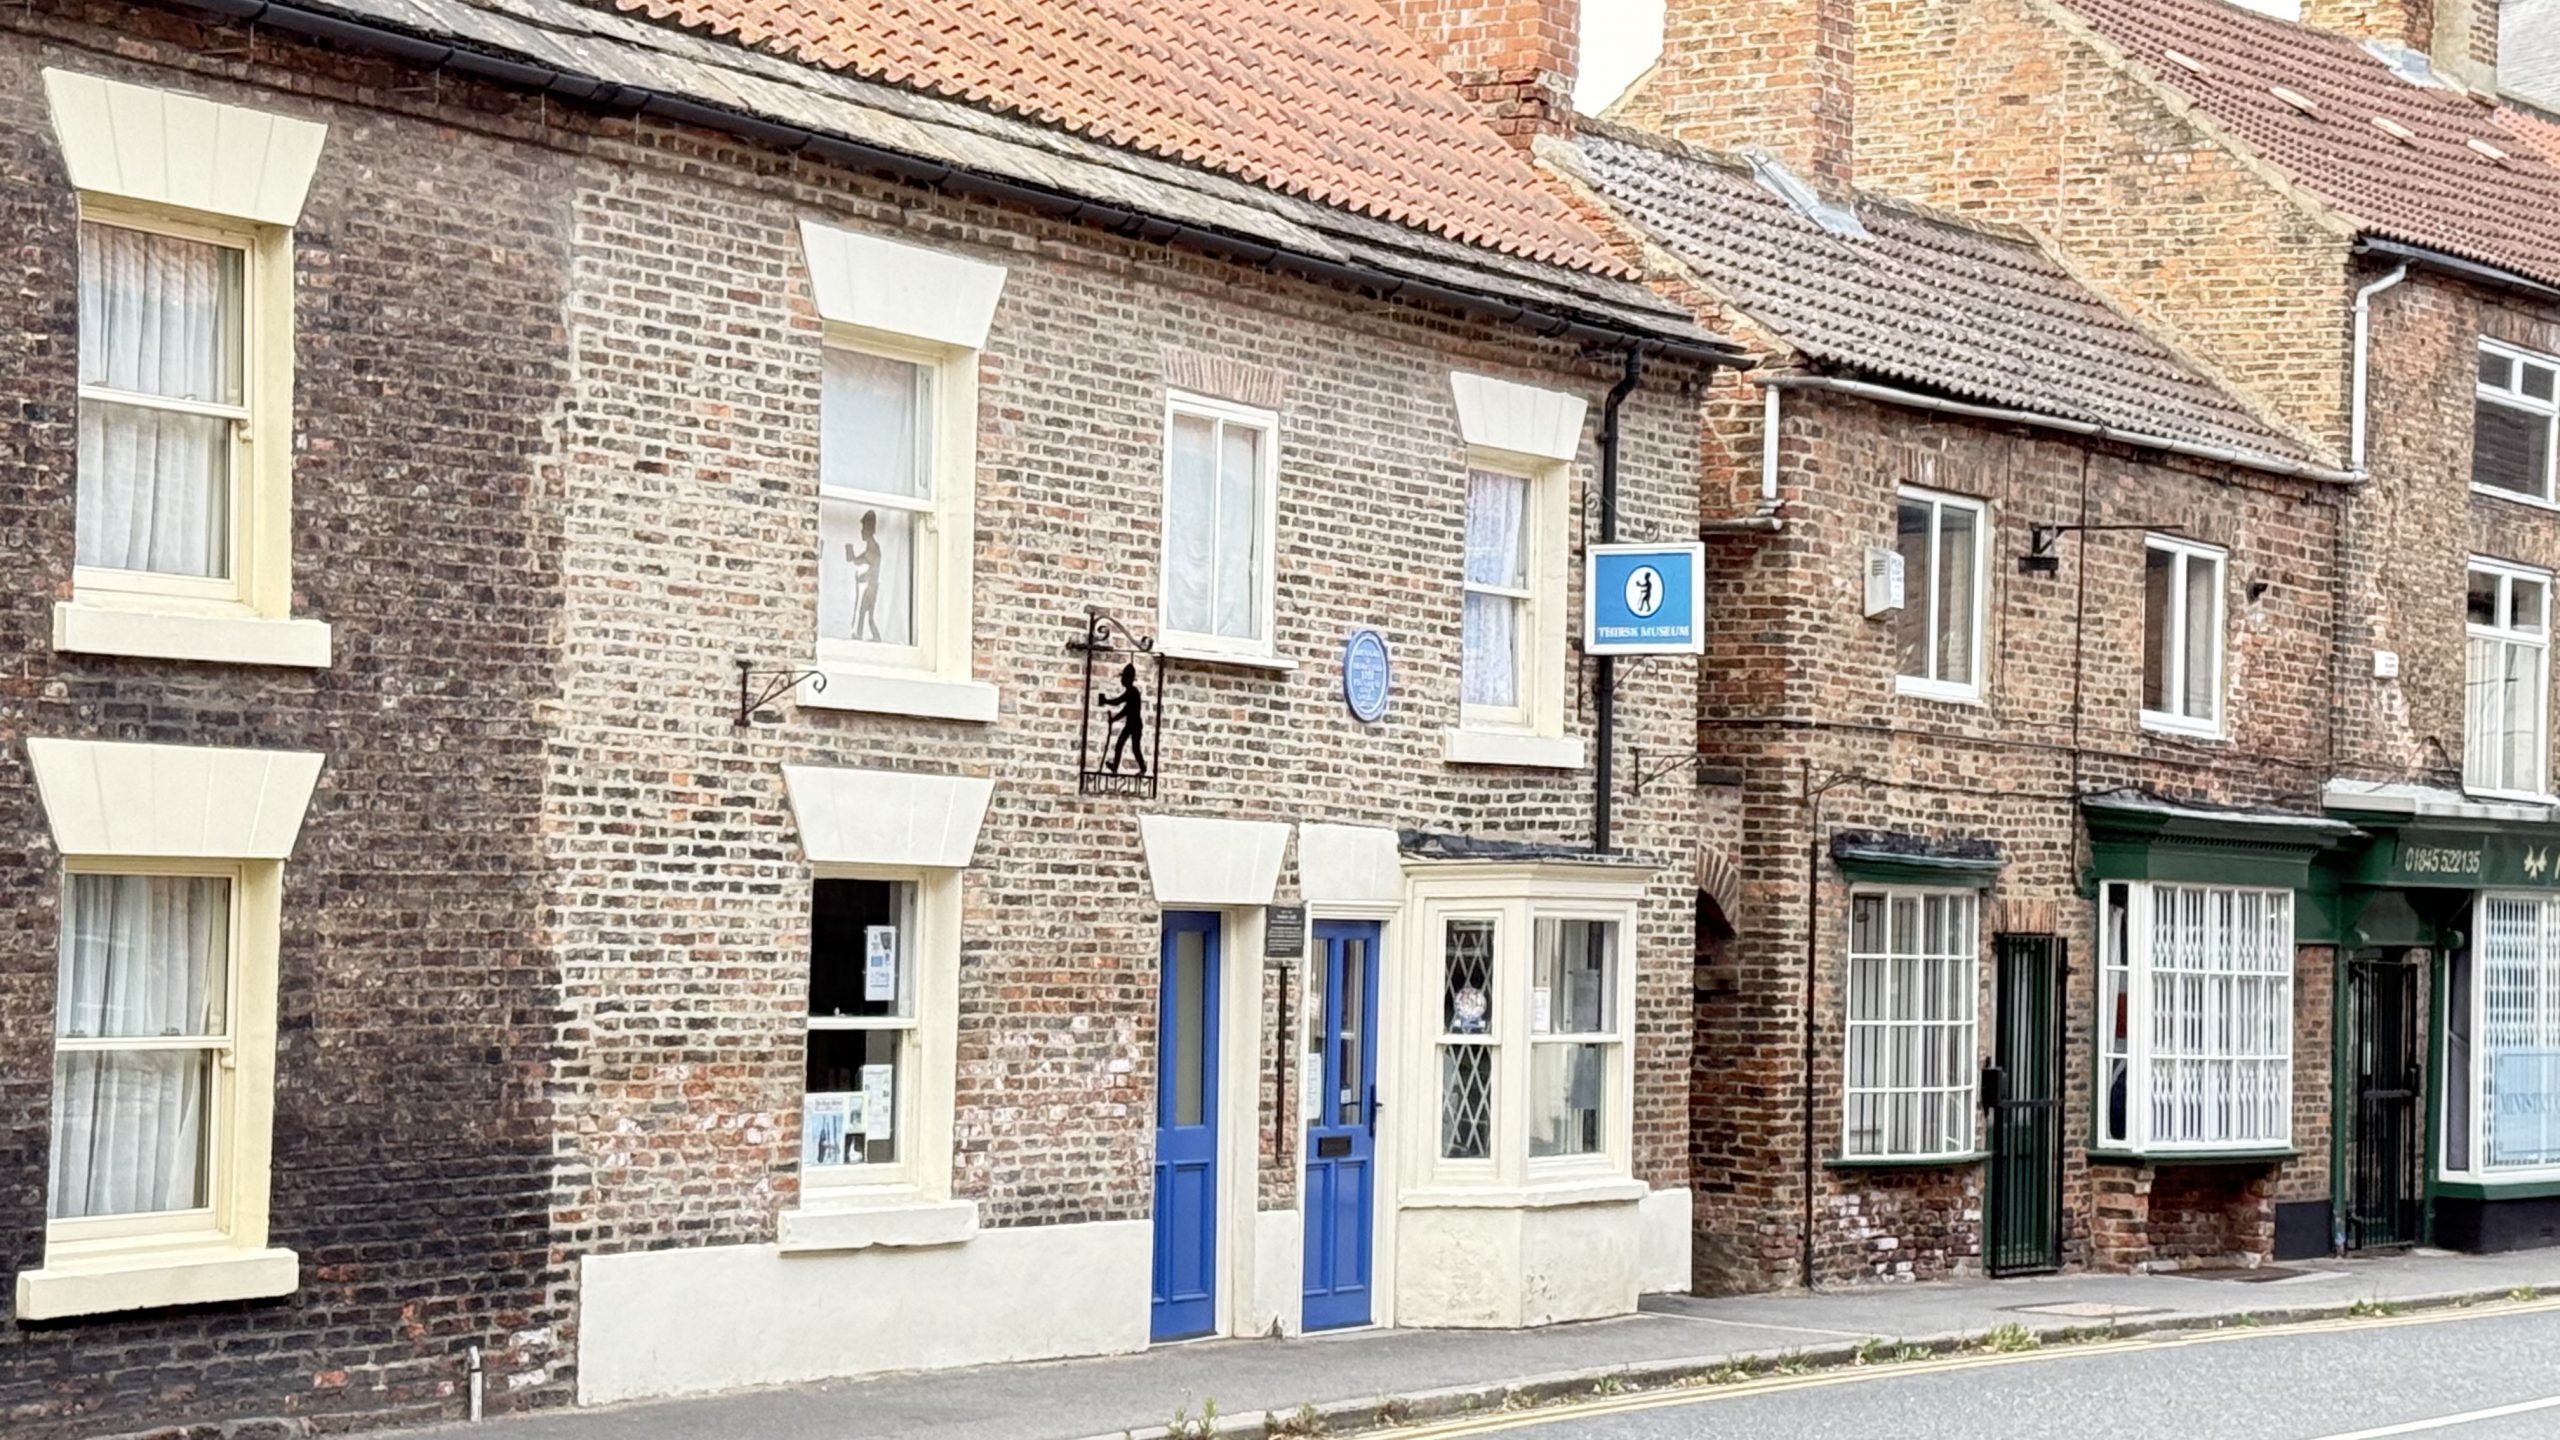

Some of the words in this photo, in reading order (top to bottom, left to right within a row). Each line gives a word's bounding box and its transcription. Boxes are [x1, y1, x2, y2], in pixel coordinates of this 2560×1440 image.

[1597, 626, 1638, 637] THIRSK
[1641, 625, 1689, 637] MUSEUM
[2405, 847, 2439, 873] 01845
[2440, 849, 2480, 874] 522135
